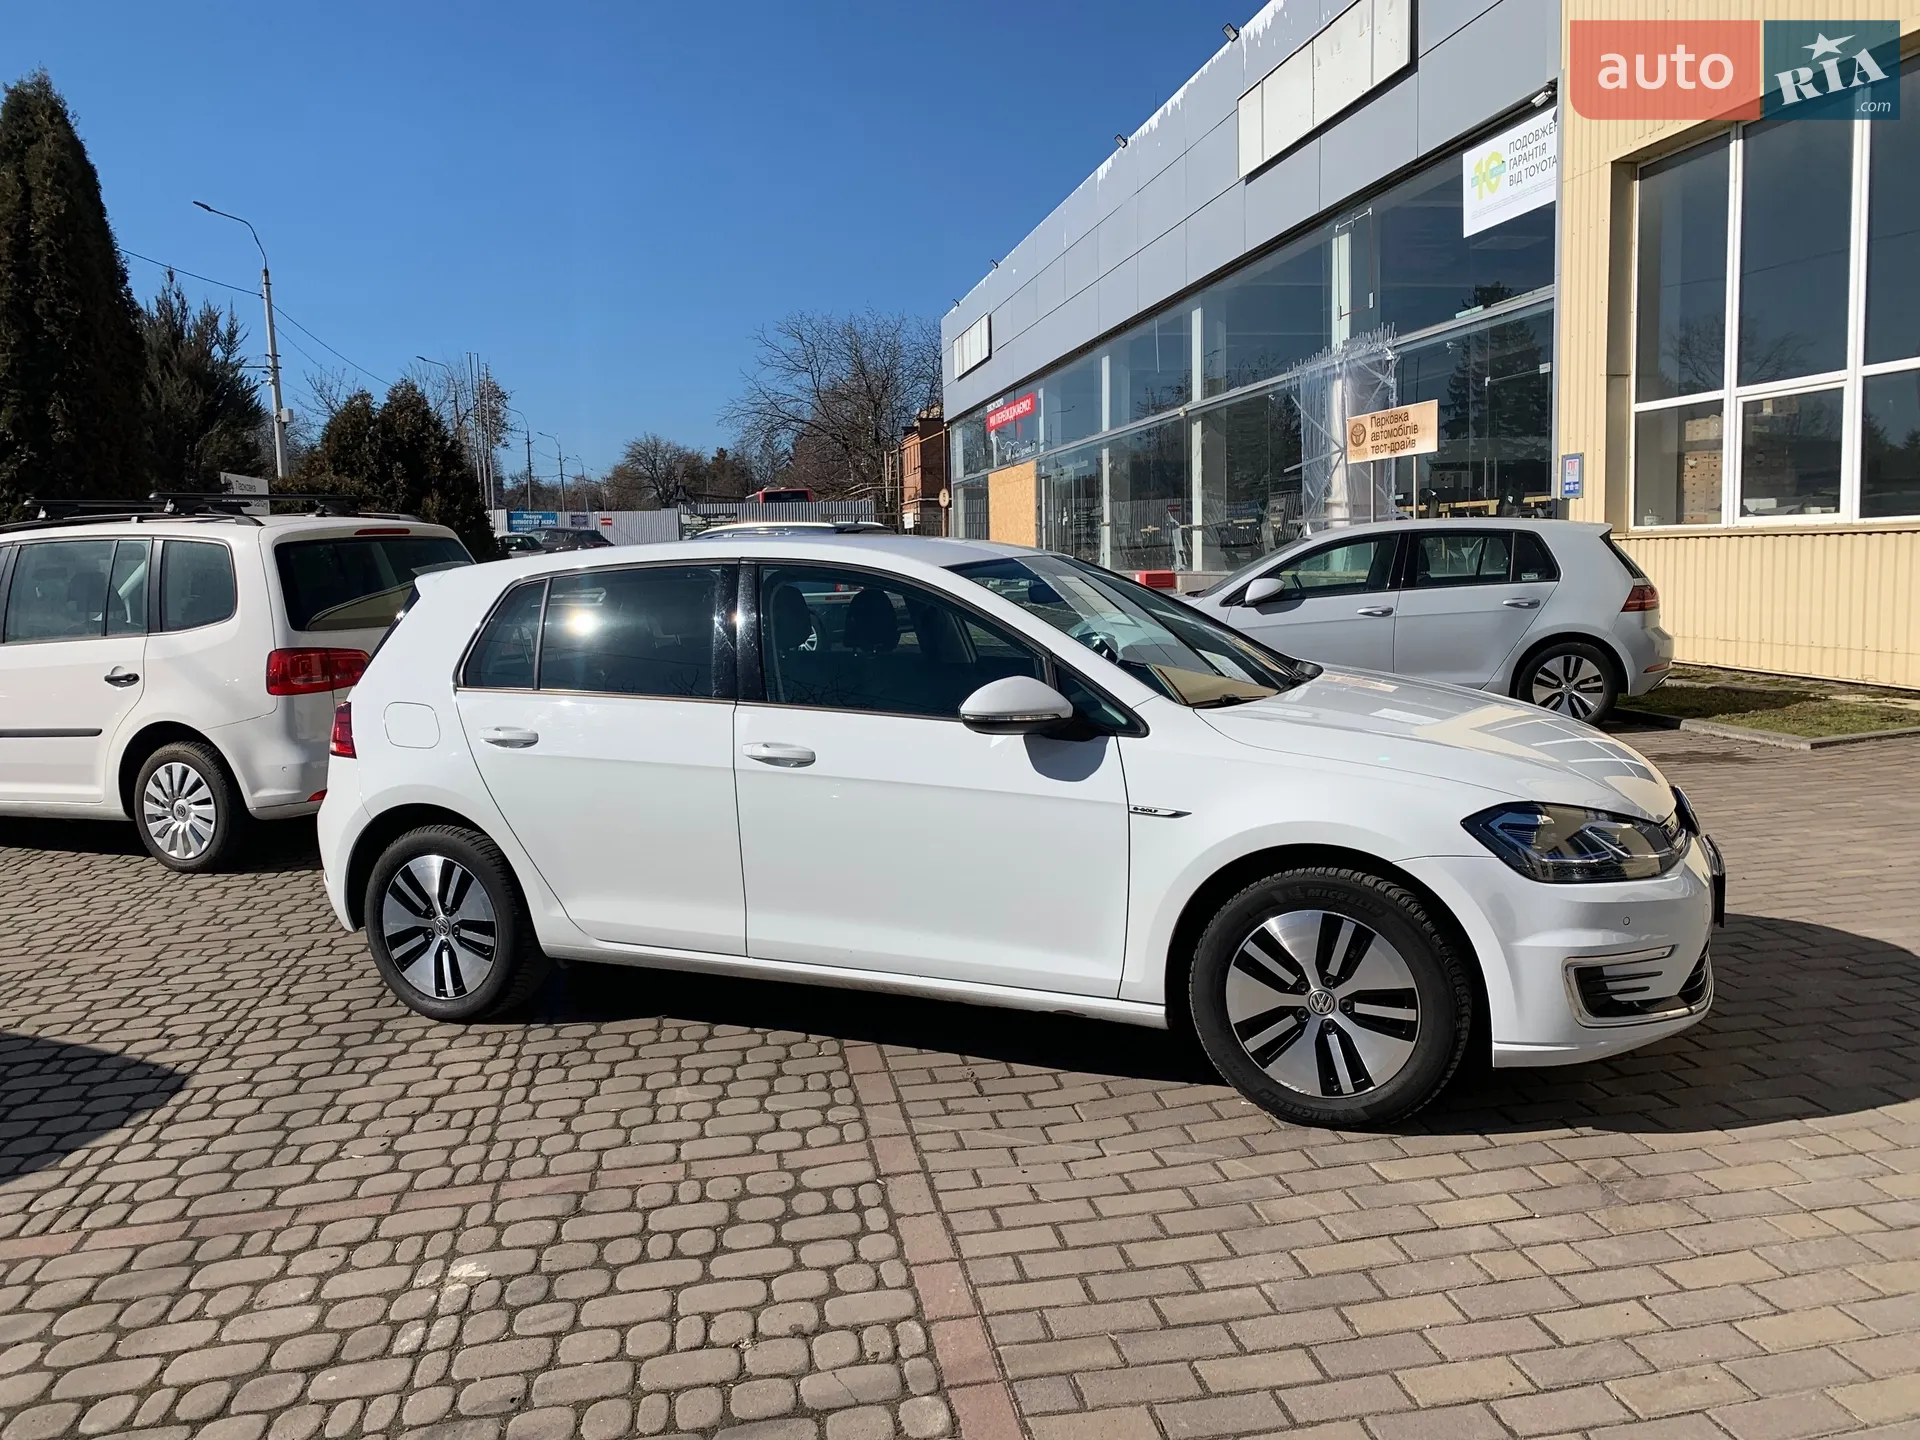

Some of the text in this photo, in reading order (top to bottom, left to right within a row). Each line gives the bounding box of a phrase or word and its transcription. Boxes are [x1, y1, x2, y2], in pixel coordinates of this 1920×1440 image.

[1508, 142, 1547, 171] ГАРАНТІЯ
[1508, 170, 1523, 187] ВІД
[1524, 154, 1558, 179] TOYOTA
[1370, 411, 1409, 429] Парковка
[1370, 422, 1419, 442] автомобілів
[1370, 436, 1416, 455] тест-драйв
